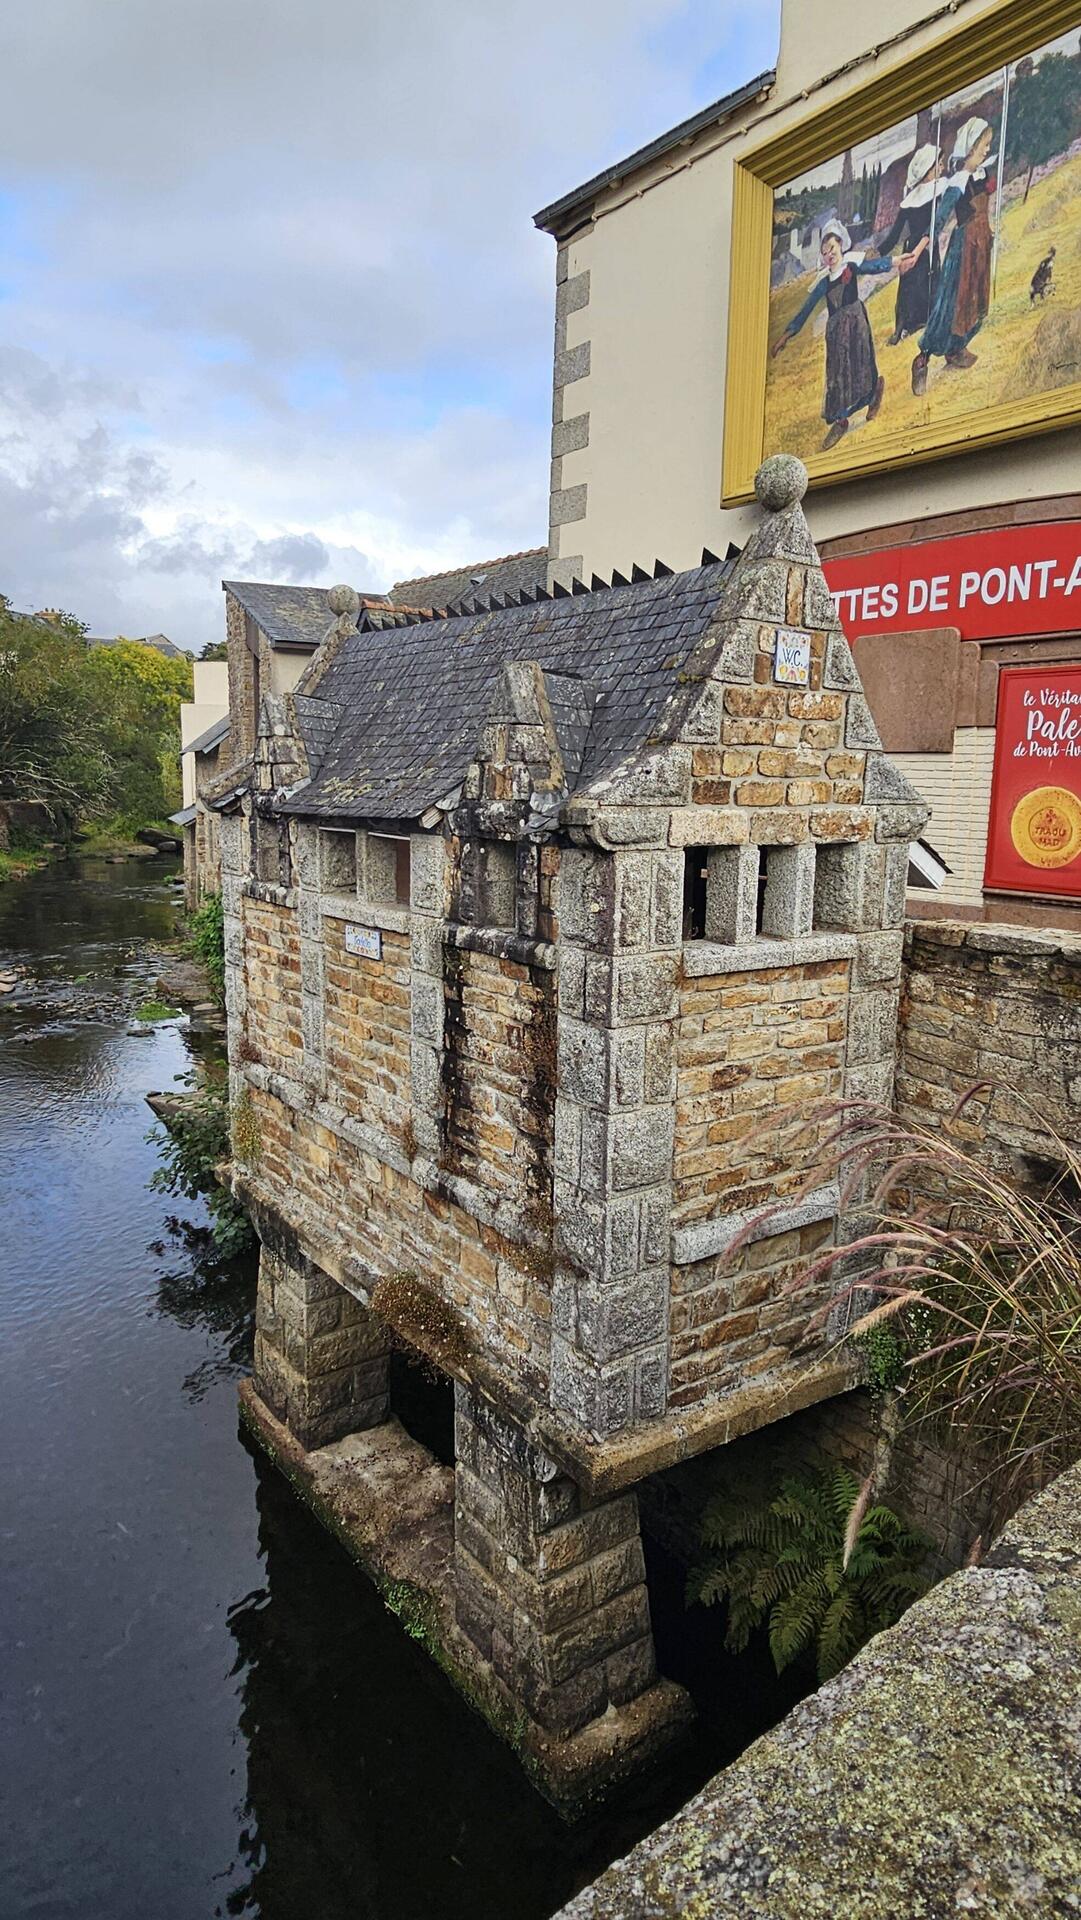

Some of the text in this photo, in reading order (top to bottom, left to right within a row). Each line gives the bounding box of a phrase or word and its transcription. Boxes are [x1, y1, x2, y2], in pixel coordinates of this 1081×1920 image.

[907, 575, 950, 614] DE
[1023, 688, 1081, 708] le Vérita
[1027, 707, 1081, 740] Pale
[1013, 741, 1028, 757] de
